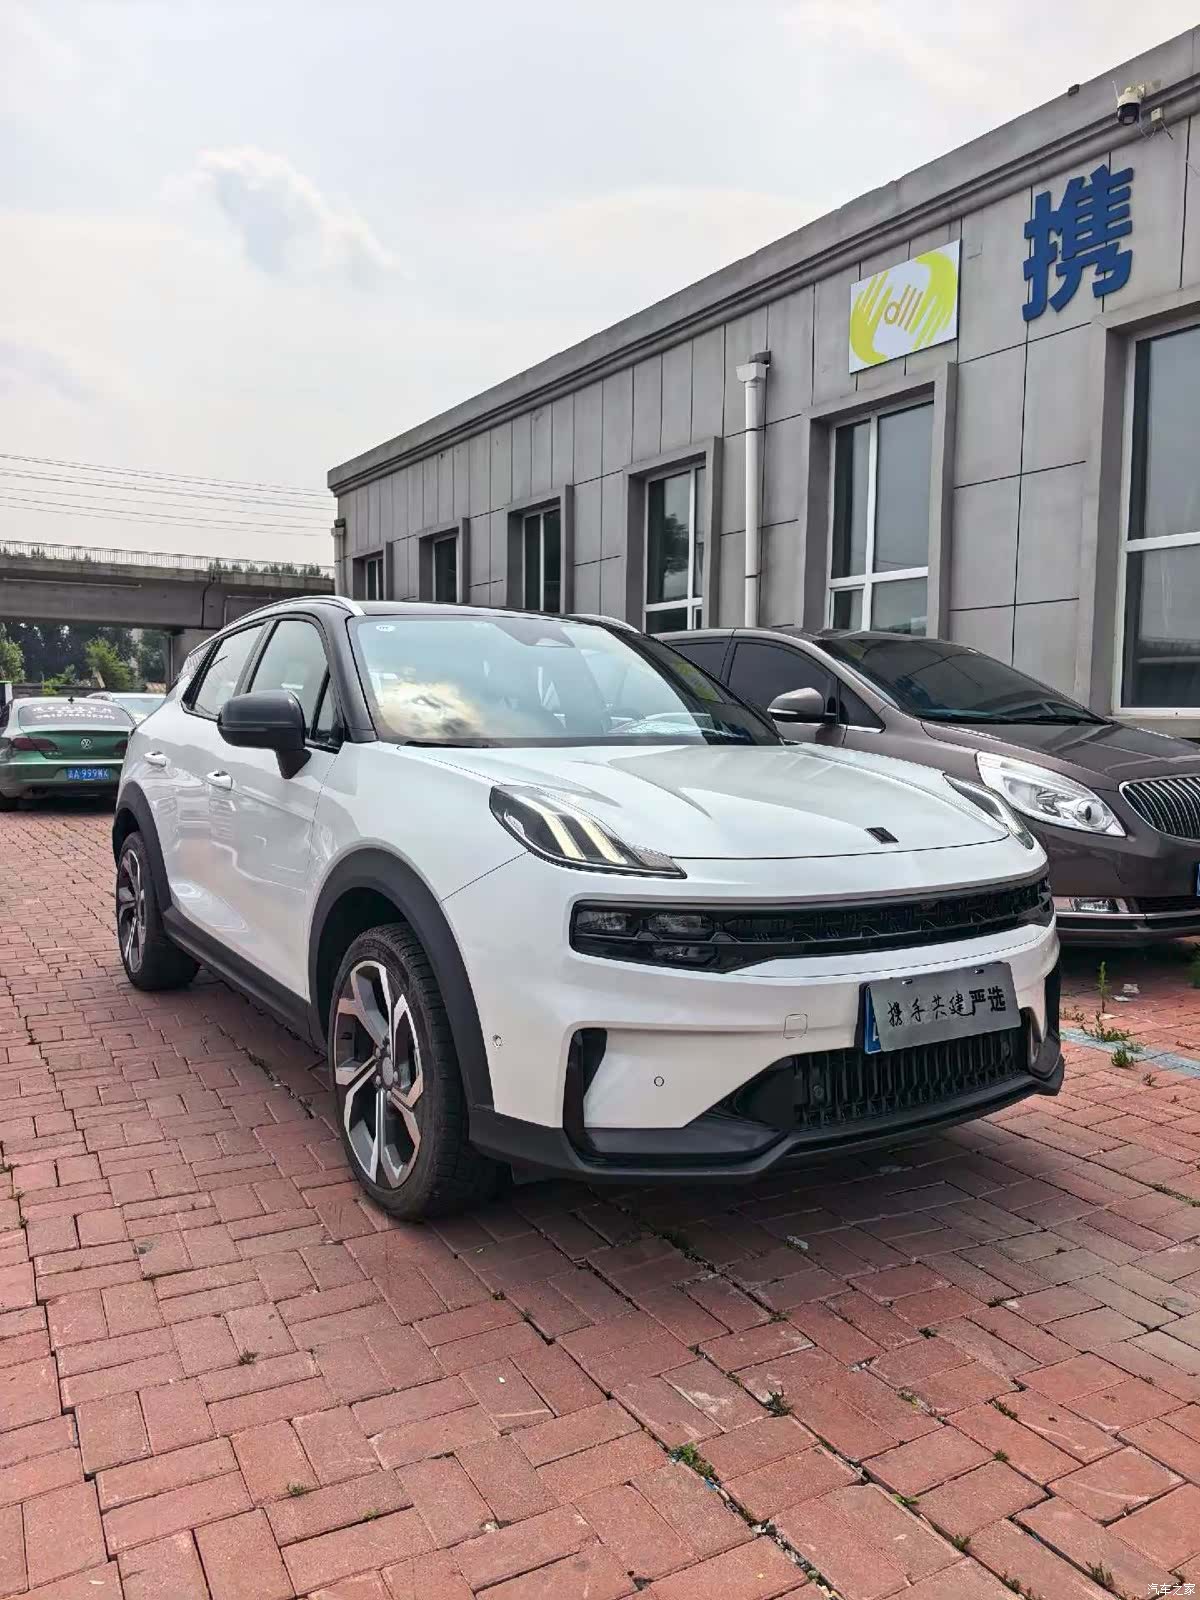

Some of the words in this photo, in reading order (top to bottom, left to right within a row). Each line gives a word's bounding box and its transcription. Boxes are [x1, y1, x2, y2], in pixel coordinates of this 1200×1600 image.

[1022, 164, 1134, 322] 携
[887, 985, 1007, 1028] 携手共建严选
